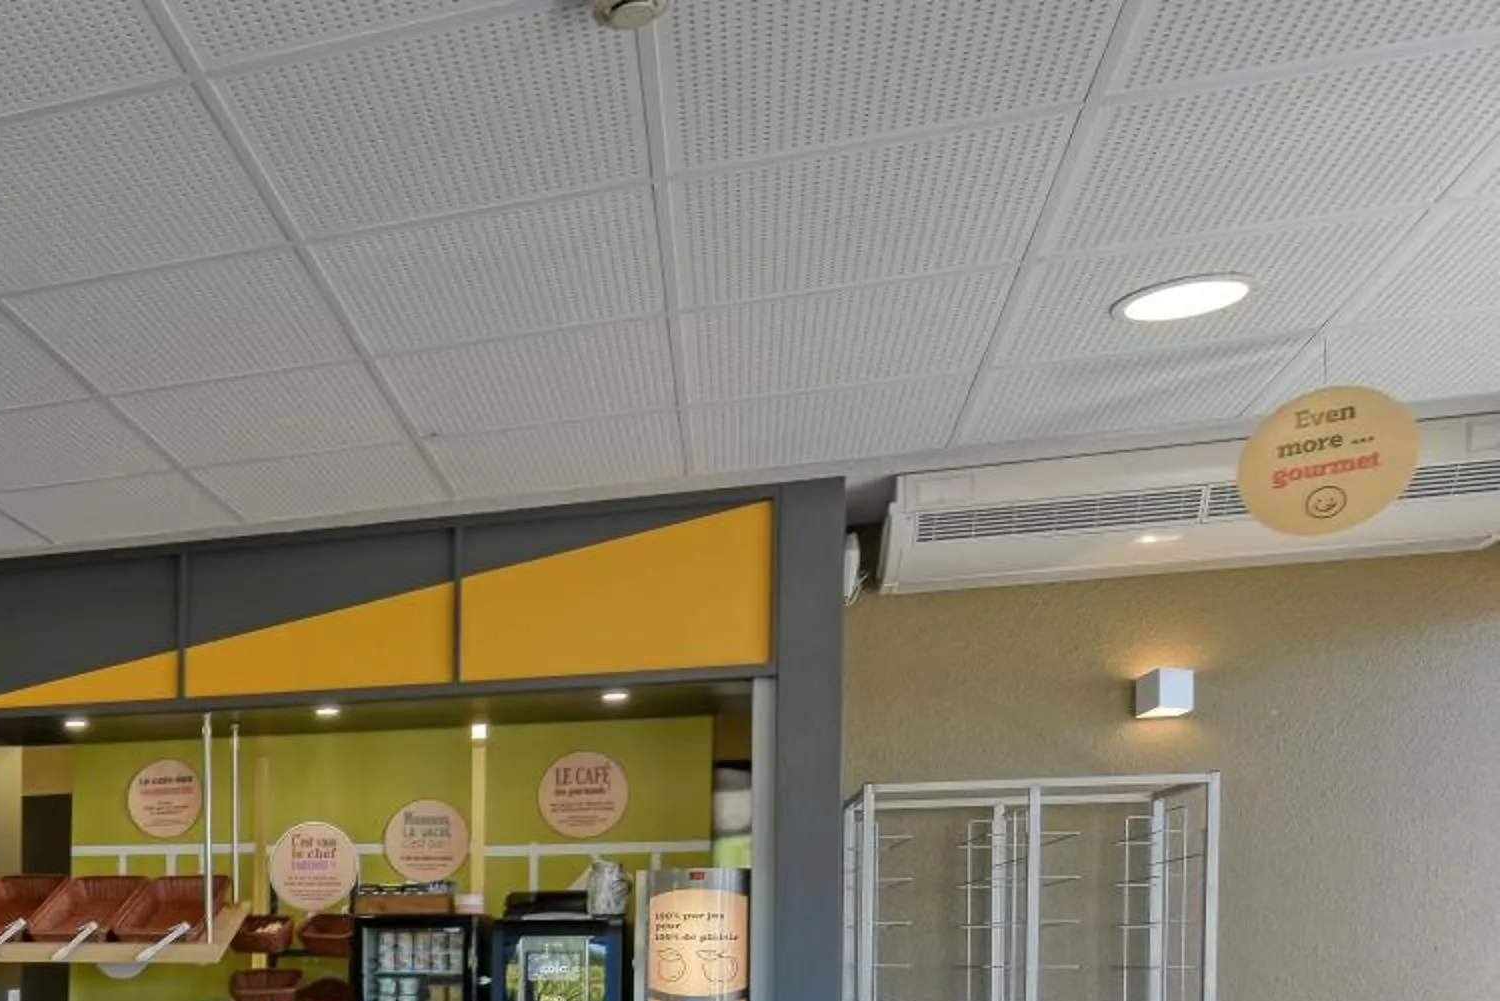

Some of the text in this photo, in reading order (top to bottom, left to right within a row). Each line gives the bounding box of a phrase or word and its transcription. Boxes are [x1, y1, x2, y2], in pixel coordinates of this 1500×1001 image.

[1294, 405, 1356, 429] Even
[1277, 433, 1343, 459] more
[1271, 451, 1381, 489] gourmet
[555, 761, 611, 785] LE CAFÉ
[307, 847, 337, 859] chef
